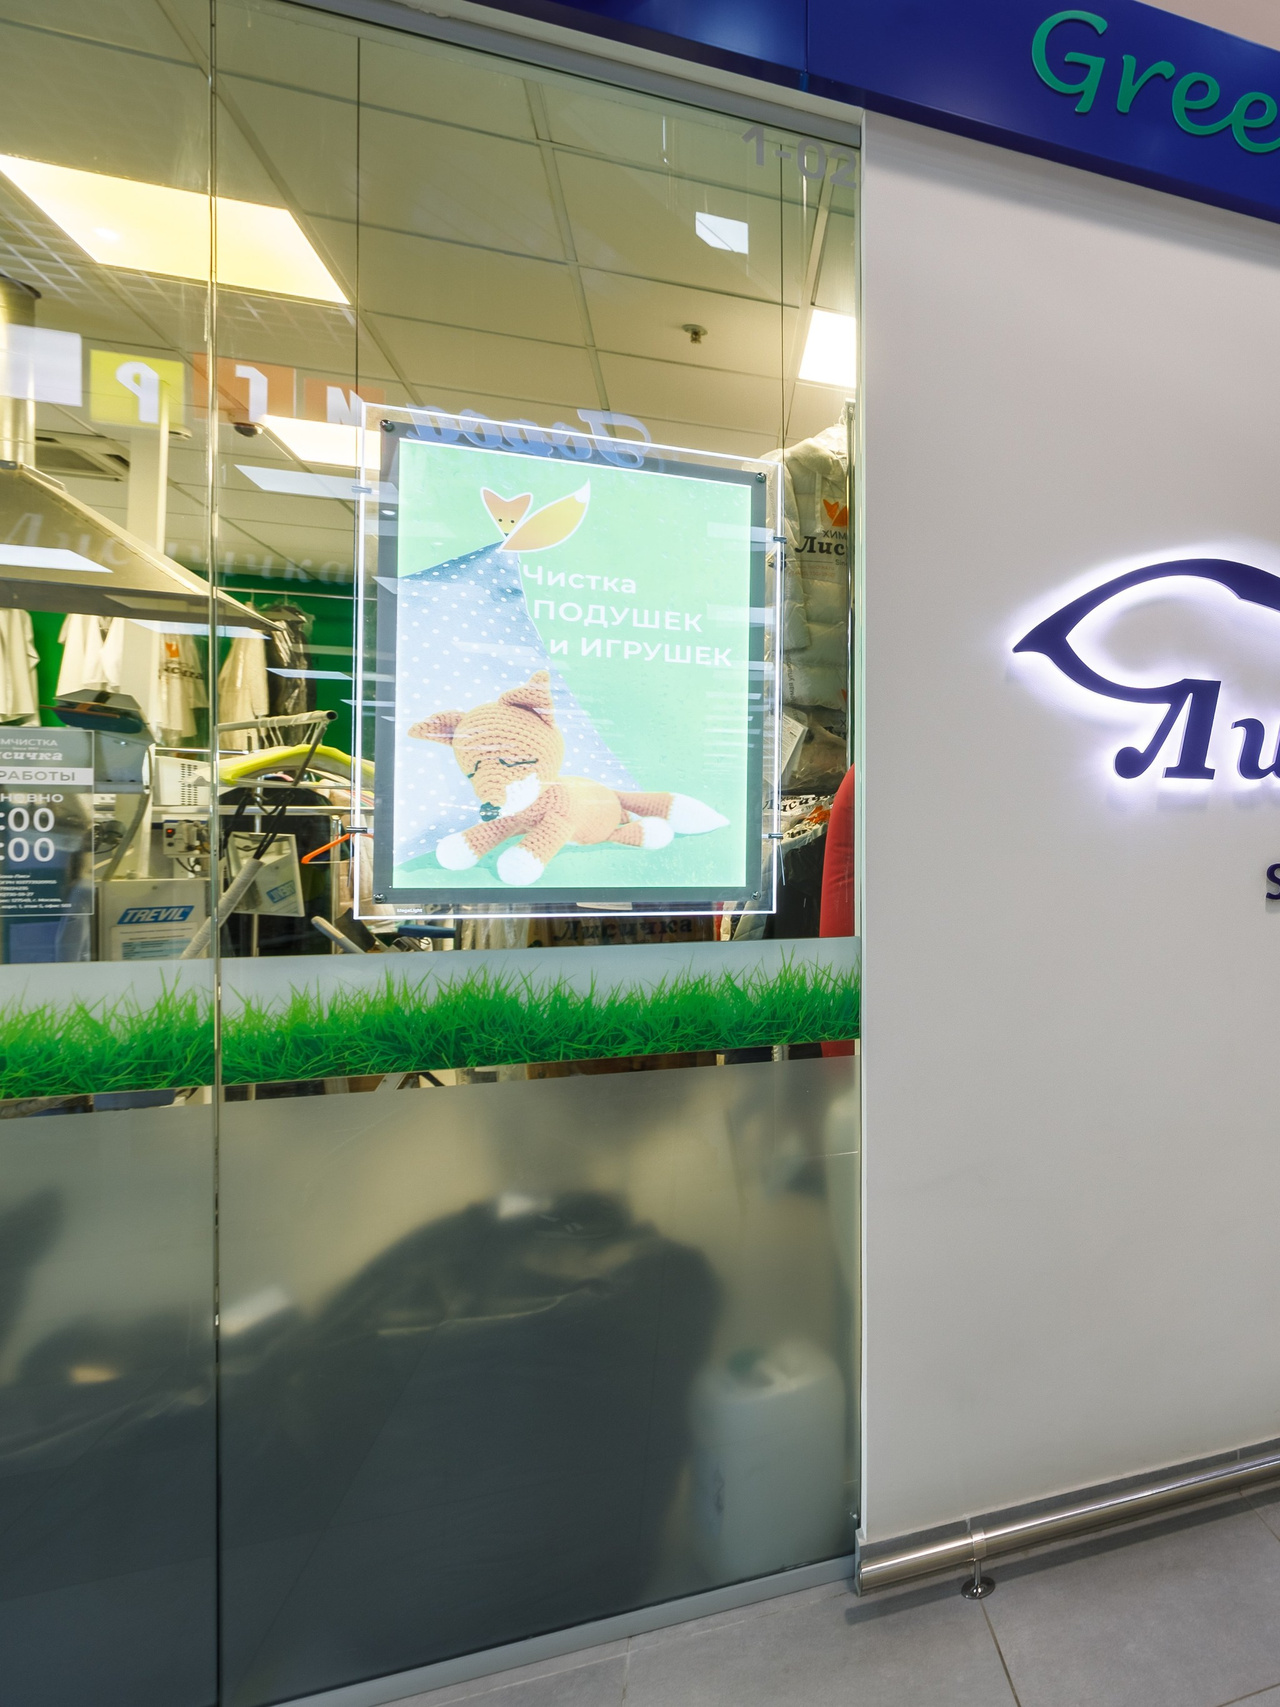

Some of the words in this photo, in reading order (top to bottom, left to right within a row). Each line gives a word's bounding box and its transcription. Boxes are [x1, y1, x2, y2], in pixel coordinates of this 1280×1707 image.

[741, 125, 857, 190] 1-02
[523, 564, 637, 594] Чистка
[533, 599, 703, 633] ПОДУШЕК
[550, 638, 569, 655] и
[580, 637, 733, 667] ИГРУШЕК
[0, 750, 63, 761] сичка
[123, 908, 187, 923] TREVIL
